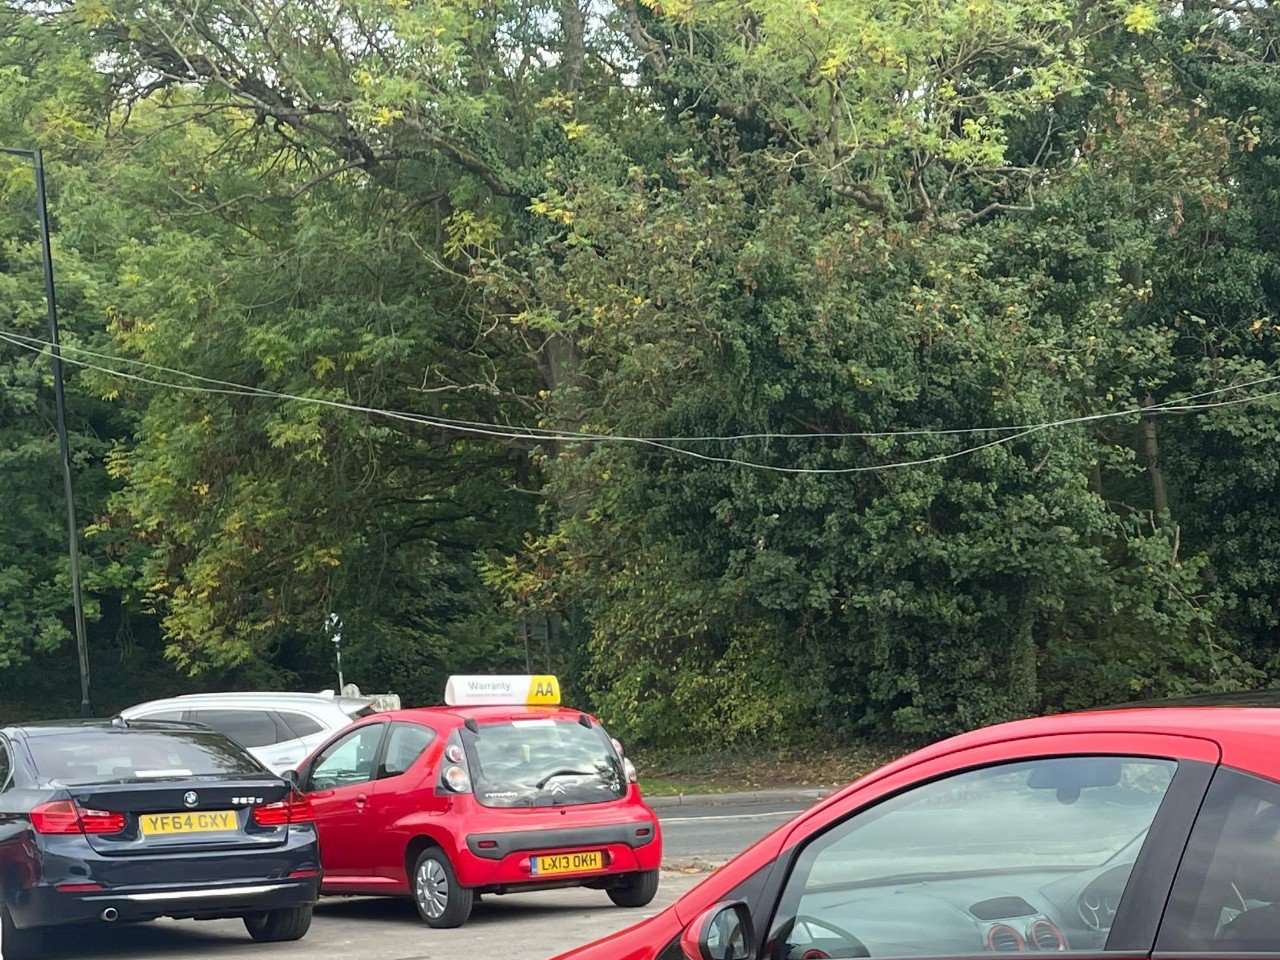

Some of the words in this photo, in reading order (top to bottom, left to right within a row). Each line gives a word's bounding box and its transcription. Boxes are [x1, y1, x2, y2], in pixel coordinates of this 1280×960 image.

[467, 680, 511, 692] Warranty
[536, 682, 554, 696] AA
[149, 815, 193, 831] YF64
[197, 814, 230, 829] GXY
[542, 856, 569, 871] LX13
[573, 854, 597, 868] OKH
